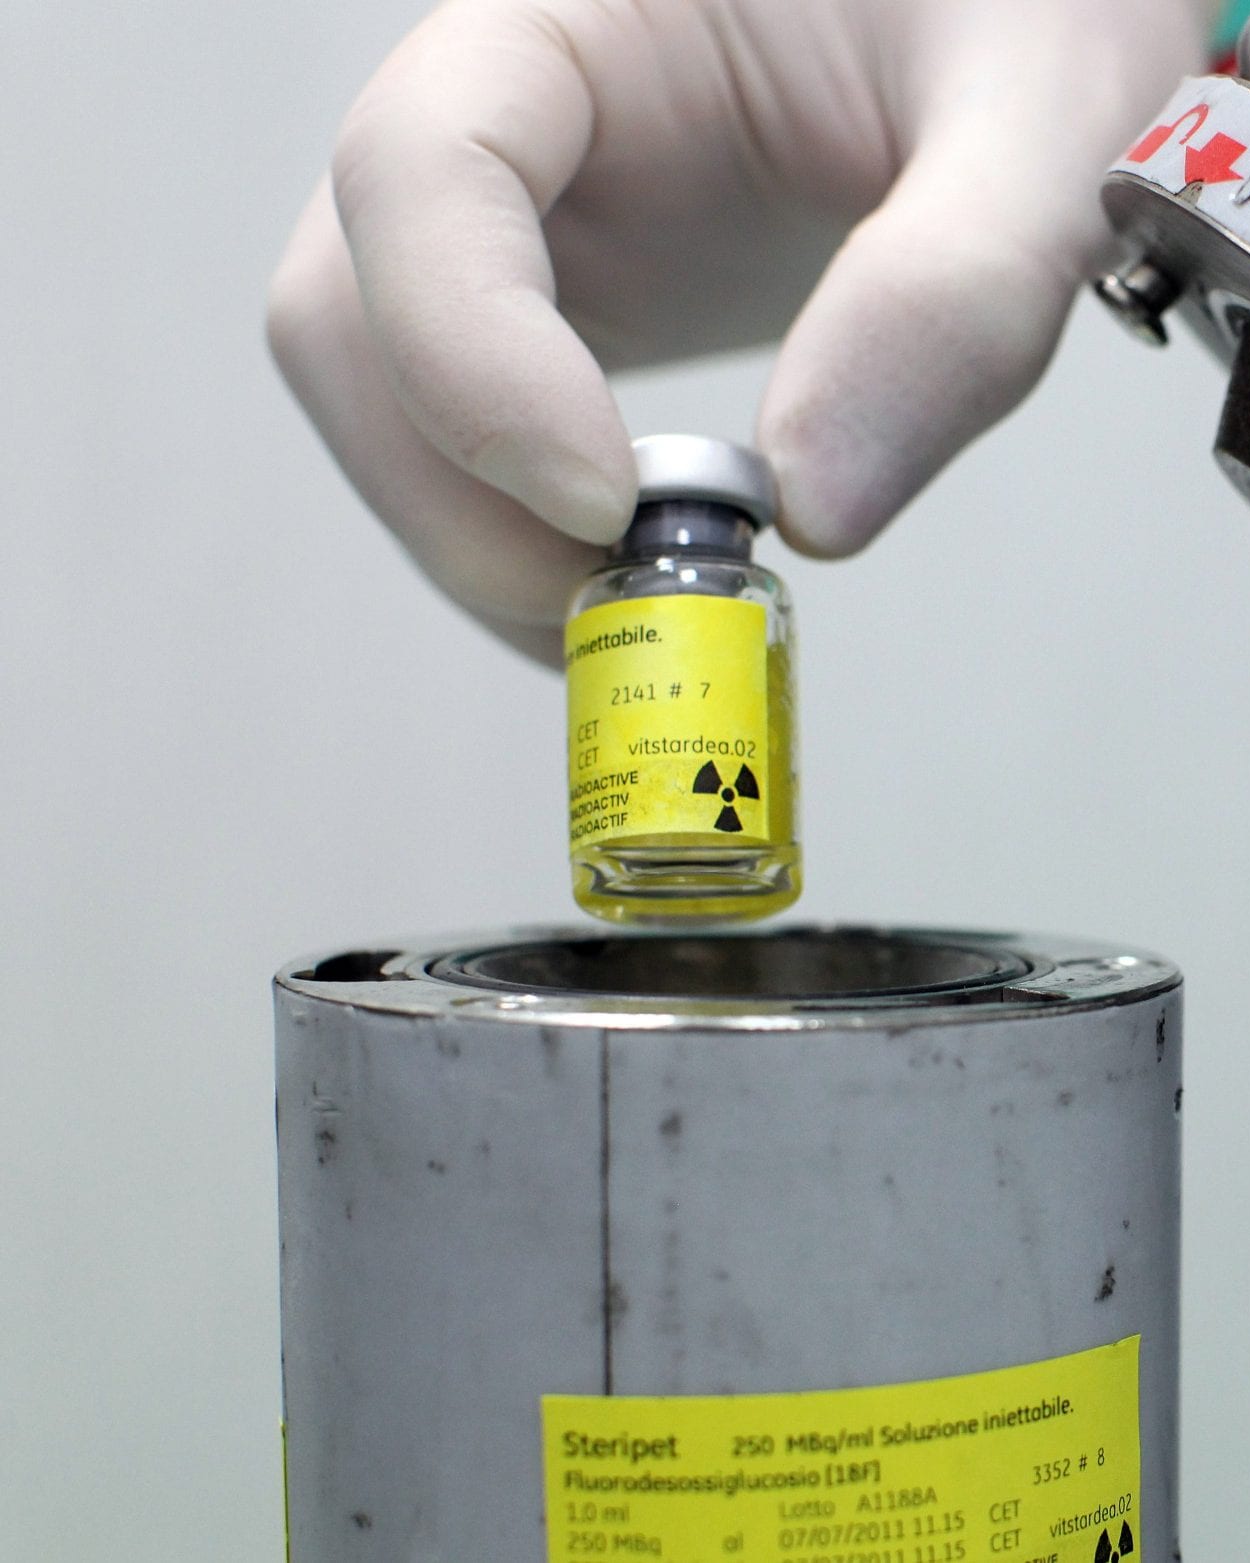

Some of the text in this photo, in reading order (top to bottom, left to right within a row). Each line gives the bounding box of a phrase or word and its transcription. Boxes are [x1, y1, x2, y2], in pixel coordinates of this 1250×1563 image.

[611, 682, 711, 706] 2141 # 7
[577, 719, 600, 744] CET
[577, 747, 600, 770] CET
[628, 735, 757, 759] vitstardea.02
[563, 1395, 1074, 1464] Steripet 250 MBq/ml Soluzione iniettabile.
[563, 1459, 881, 1497] Fluorodesossiglucosio [18F]
[1032, 1447, 1106, 1486] 3352 # 8
[567, 1502, 630, 1524] 1.0 ml
[777, 1500, 836, 1521] Lotto
[1049, 1493, 1132, 1538] vitstardea.02
[567, 1531, 607, 1554] 250
[611, 1532, 663, 1558] MBq
[778, 1518, 905, 1551] 07/07/2011
[914, 1510, 965, 1536] 11.15
[989, 1499, 1021, 1523] CET
[990, 1528, 1022, 1552] CET
